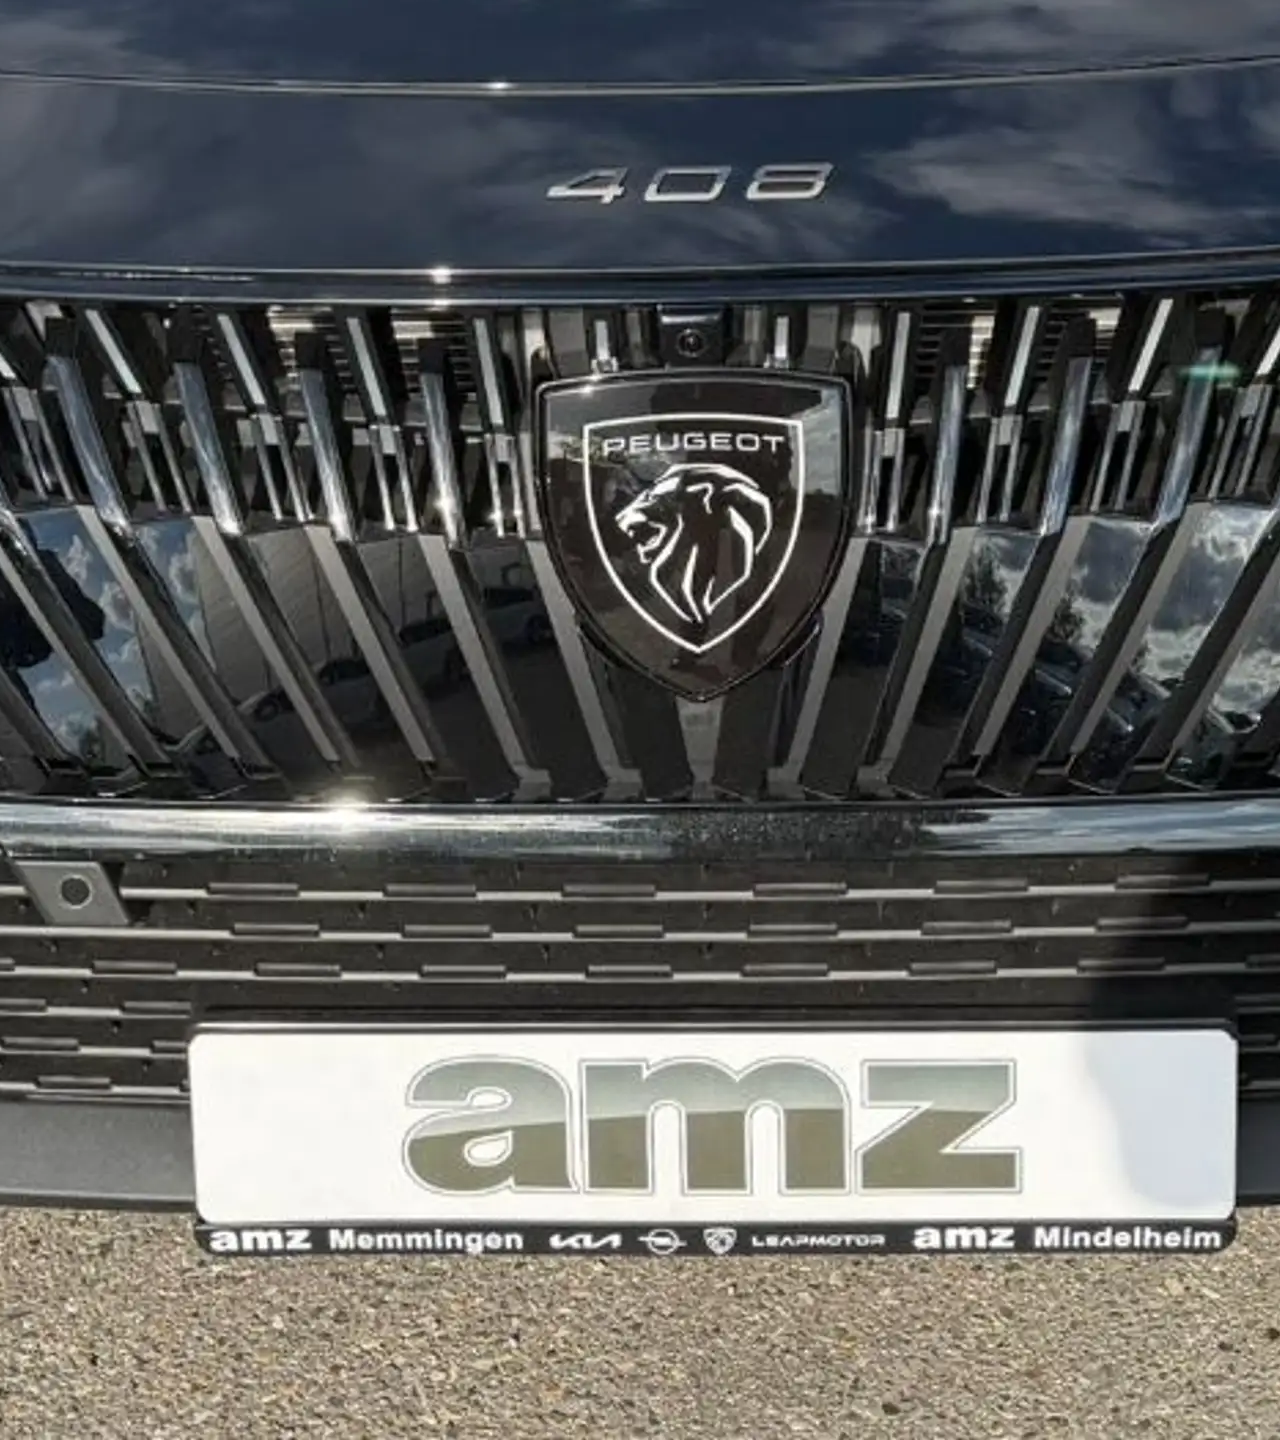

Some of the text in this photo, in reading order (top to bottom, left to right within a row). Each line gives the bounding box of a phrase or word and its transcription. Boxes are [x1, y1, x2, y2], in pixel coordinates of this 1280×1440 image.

[546, 162, 834, 205] 408
[601, 432, 786, 456] PEUGEOT
[402, 1054, 1023, 1197] amz
[209, 1228, 313, 1252] amz
[328, 1228, 524, 1254] Memmingen
[751, 1234, 886, 1249] LEAPMOTOR
[913, 1226, 1015, 1250] amz
[1034, 1226, 1222, 1249] Mindelheim
